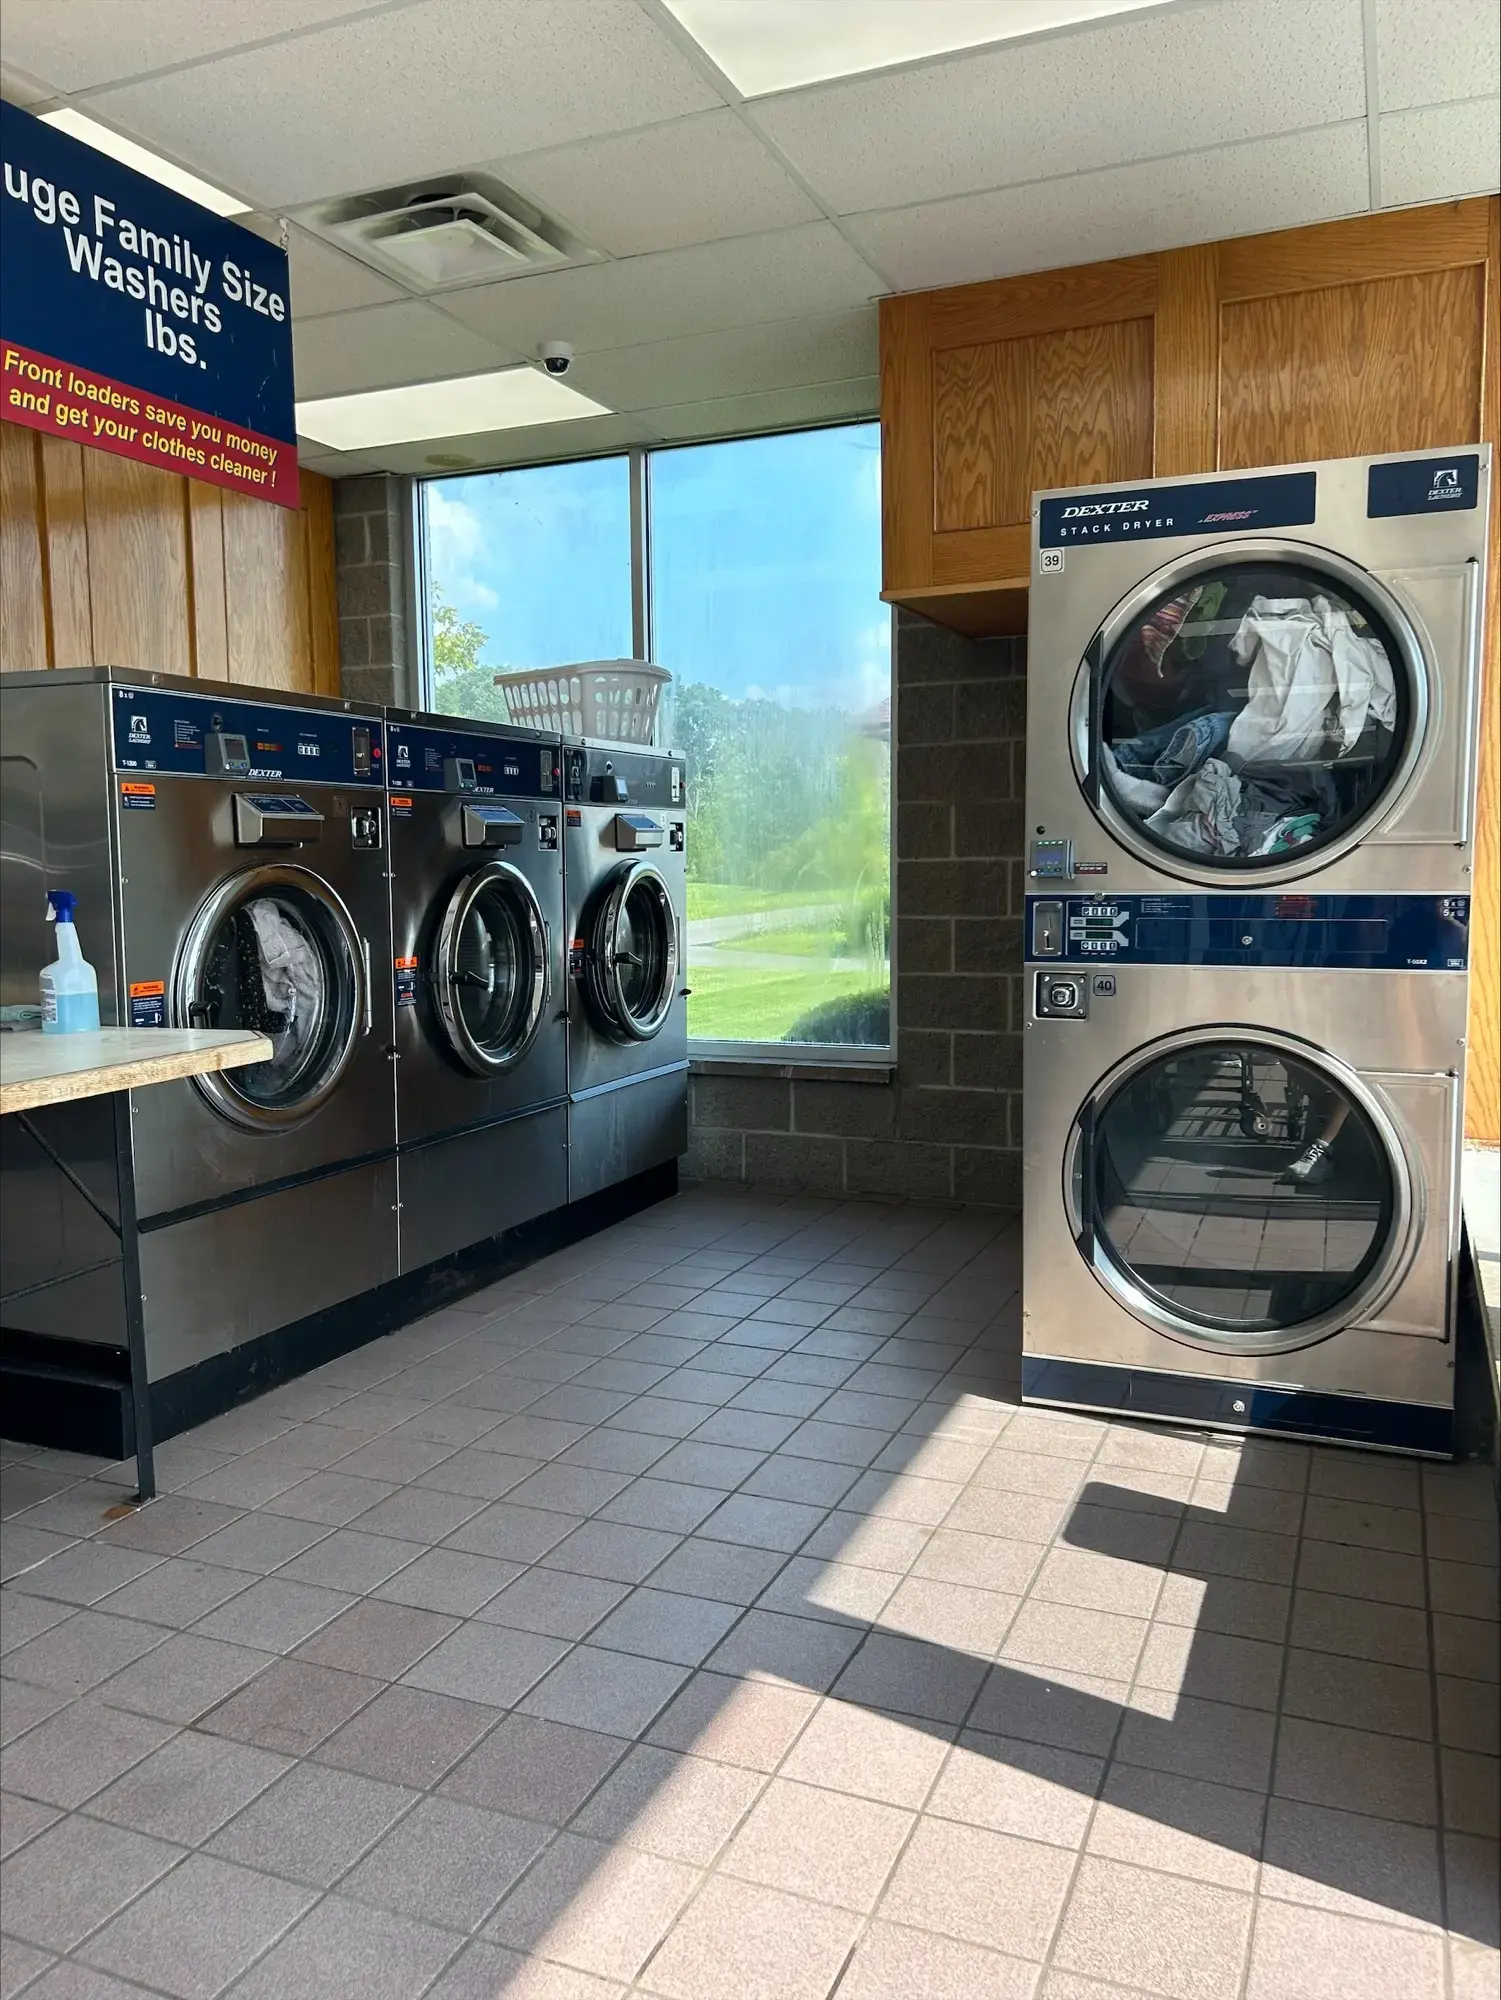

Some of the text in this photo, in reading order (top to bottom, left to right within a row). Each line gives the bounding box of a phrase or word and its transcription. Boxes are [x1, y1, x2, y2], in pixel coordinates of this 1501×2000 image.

[4, 162, 285, 322] uge Family Size
[63, 225, 222, 333] Washers
[146, 308, 207, 370] lbs.
[4, 349, 278, 466] Front loaders save you money
[9, 388, 277, 488] and get your clothes cleaner !
[1428, 487, 1462, 496] DEXTER
[1061, 500, 1149, 519] DEXTER
[1203, 510, 1251, 522] EXPRESS
[1060, 518, 1174, 536] STACK DRYER
[1044, 555, 1059, 567] 39
[248, 768, 283, 778] DEXTER
[1097, 980, 1112, 991] 40
